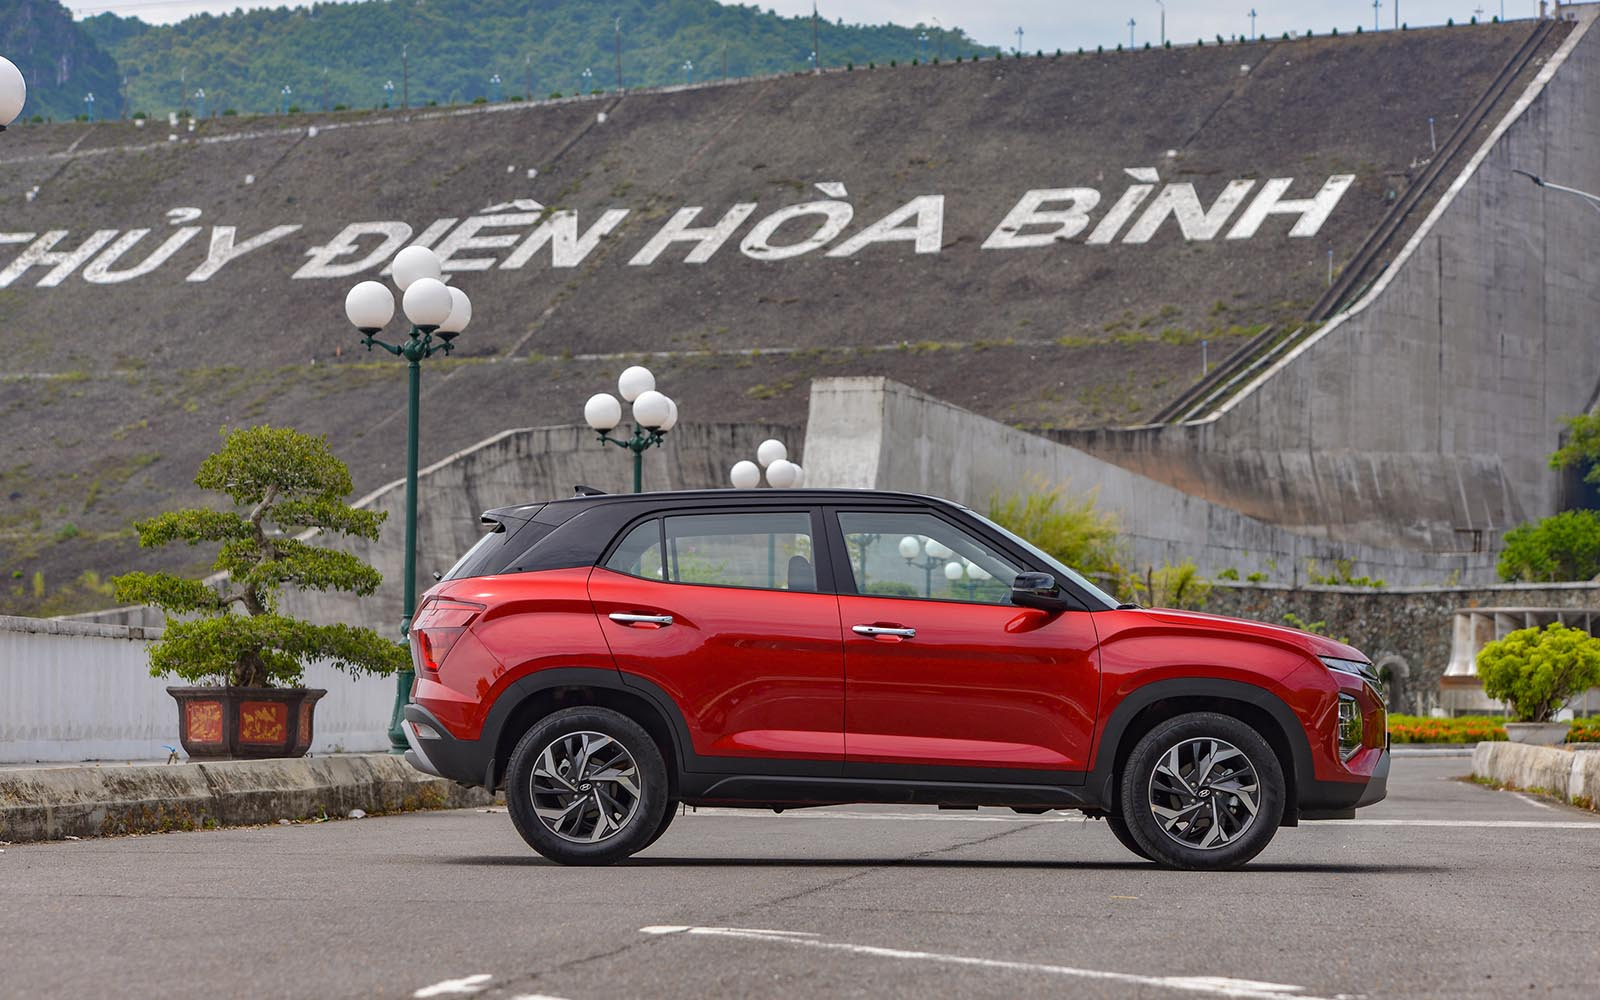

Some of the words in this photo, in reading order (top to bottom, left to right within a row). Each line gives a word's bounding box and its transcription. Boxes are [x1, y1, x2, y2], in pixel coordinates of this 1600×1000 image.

[0, 207, 302, 288] HỦY
[628, 182, 945, 265] HÒA
[981, 167, 1356, 250] BÌNH
